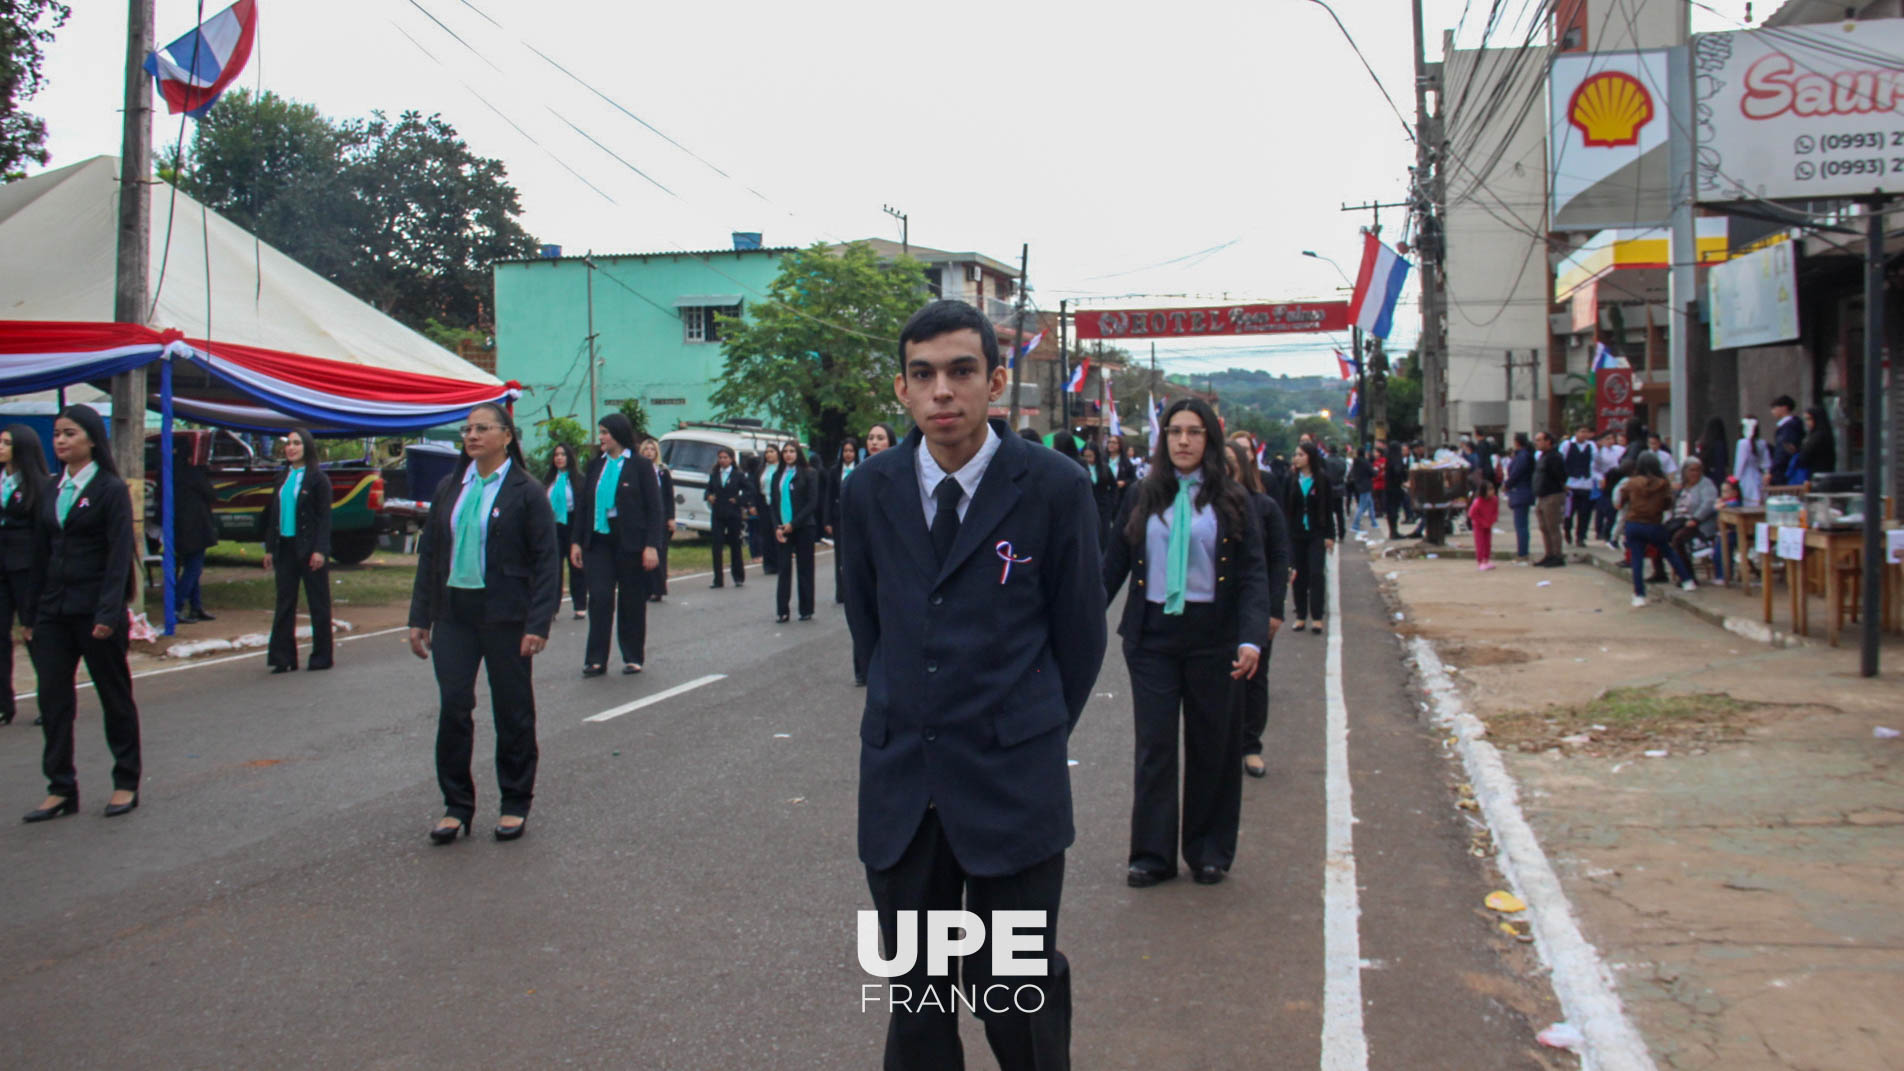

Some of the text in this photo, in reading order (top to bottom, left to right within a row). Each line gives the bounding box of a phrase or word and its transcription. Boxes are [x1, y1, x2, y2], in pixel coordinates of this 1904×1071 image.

[1820, 131, 1904, 153] (0993) 2
[1820, 157, 1904, 180] (0993) 2
[1130, 310, 1225, 334] HOTEL
